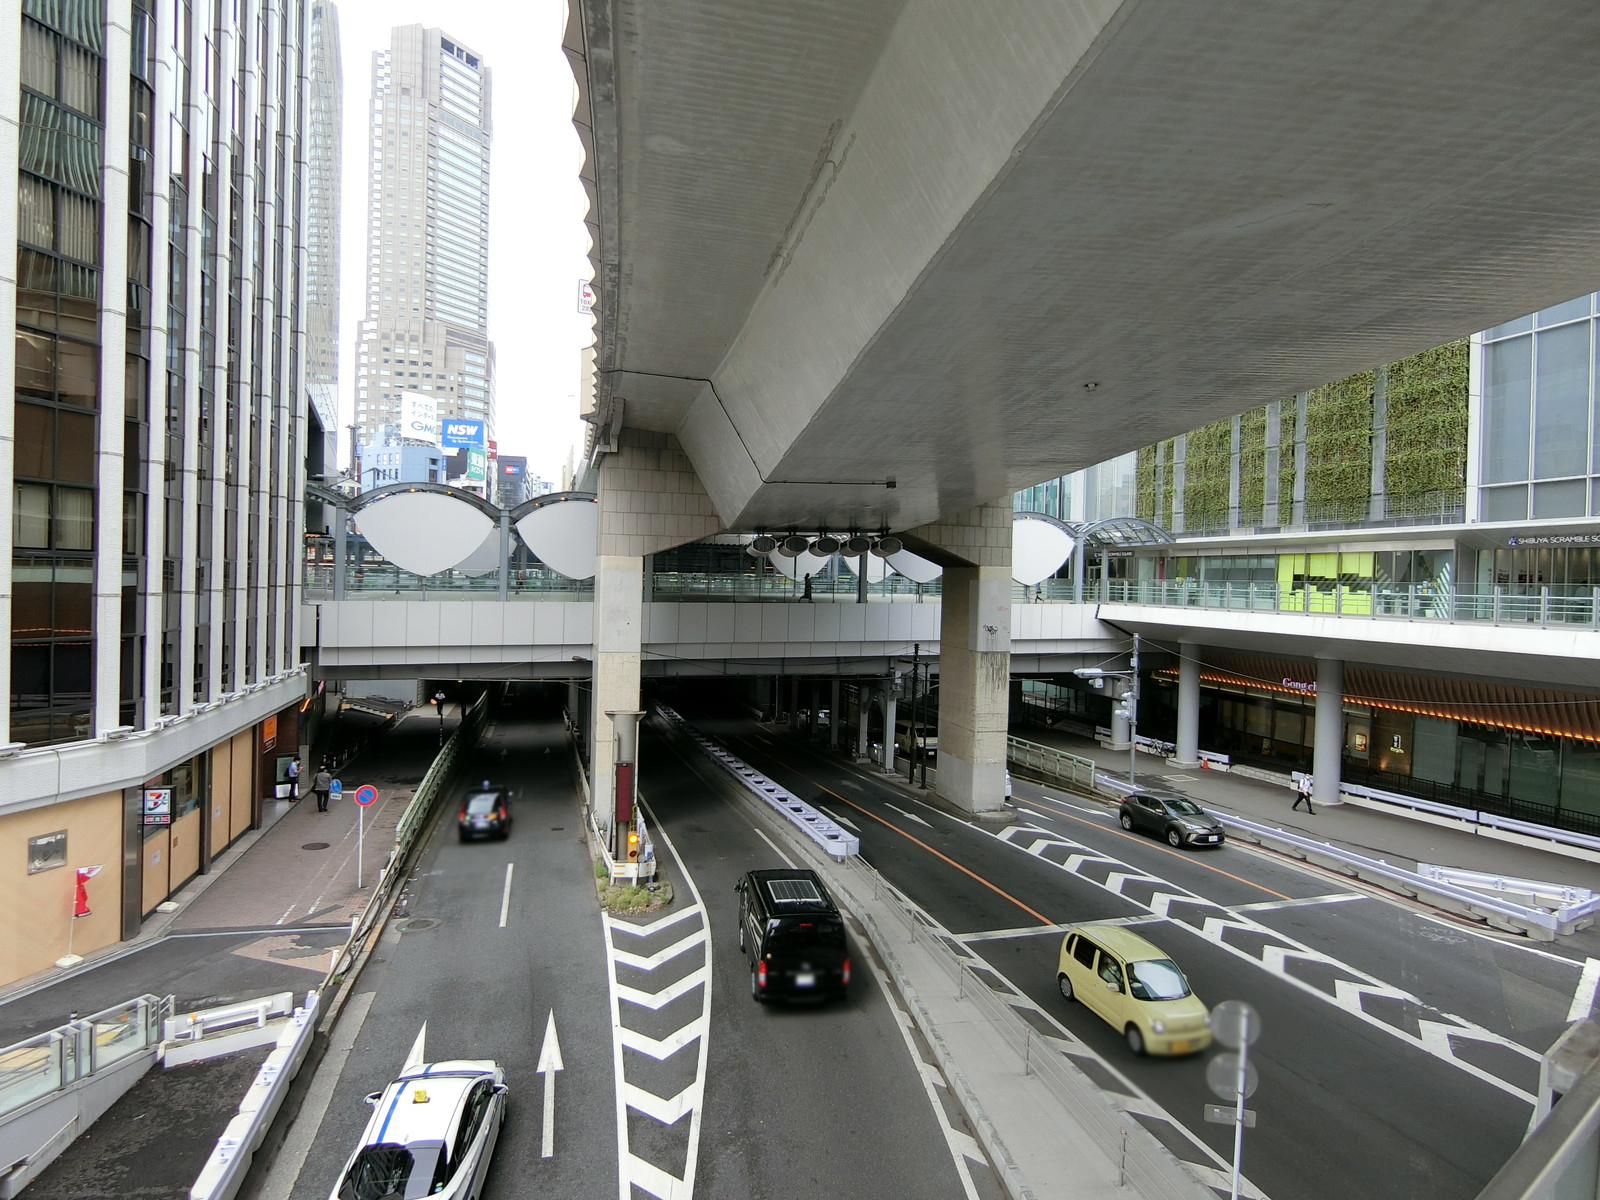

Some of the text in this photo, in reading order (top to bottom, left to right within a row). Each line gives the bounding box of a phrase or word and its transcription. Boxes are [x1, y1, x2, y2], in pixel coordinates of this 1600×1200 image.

[447, 424, 478, 436] NSW
[1518, 537, 1549, 545] SHIBUYA
[1550, 535, 1590, 544] SCRAMBLE
[1282, 677, 1307, 693] Gong
